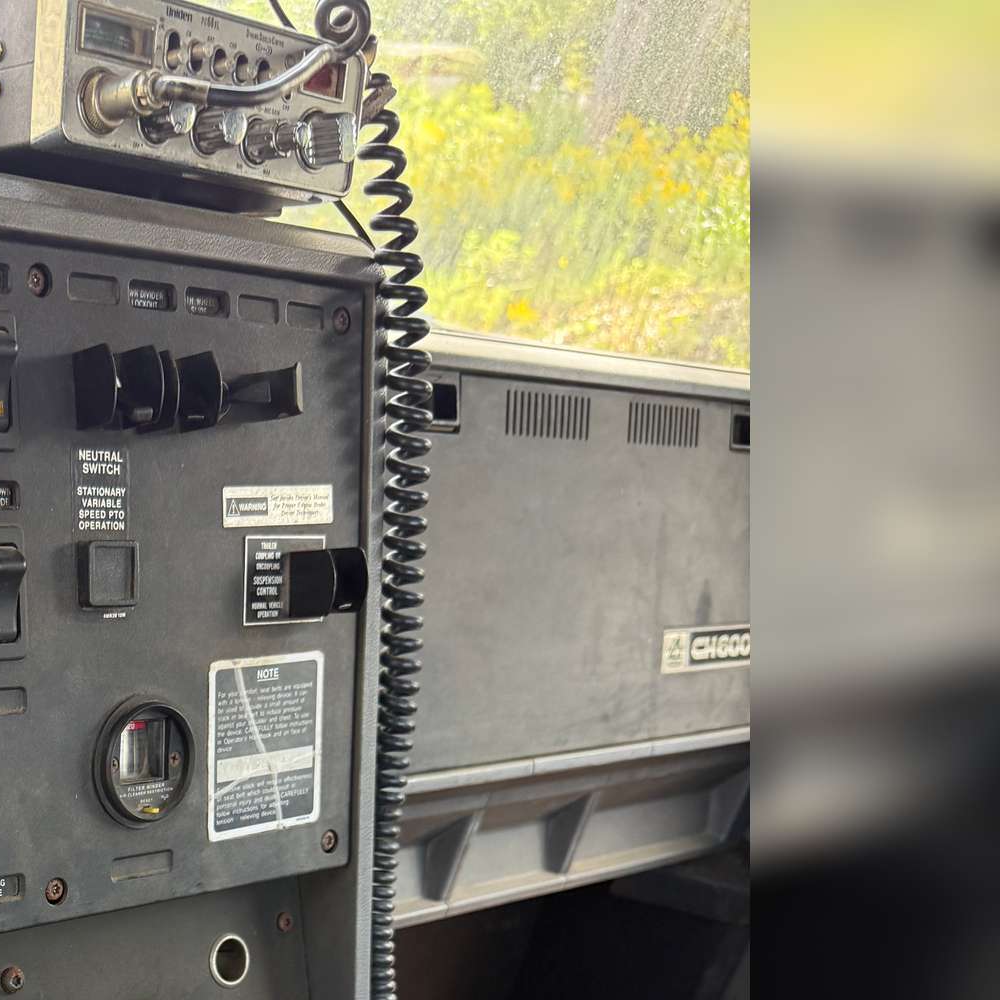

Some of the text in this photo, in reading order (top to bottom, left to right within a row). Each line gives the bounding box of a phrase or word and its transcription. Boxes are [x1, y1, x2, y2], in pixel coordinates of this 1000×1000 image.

[78, 449, 123, 462] NEUTRAL
[82, 463, 121, 475] SWITCH
[77, 486, 126, 497] STATIONARY
[82, 499, 122, 508] VARIABLE
[79, 509, 125, 520] SPEED PTO
[79, 521, 125, 531] OPERATION
[253, 576, 283, 585] SUSPENSION
[256, 587, 278, 596] CONTROL
[257, 668, 280, 679] NOTE
